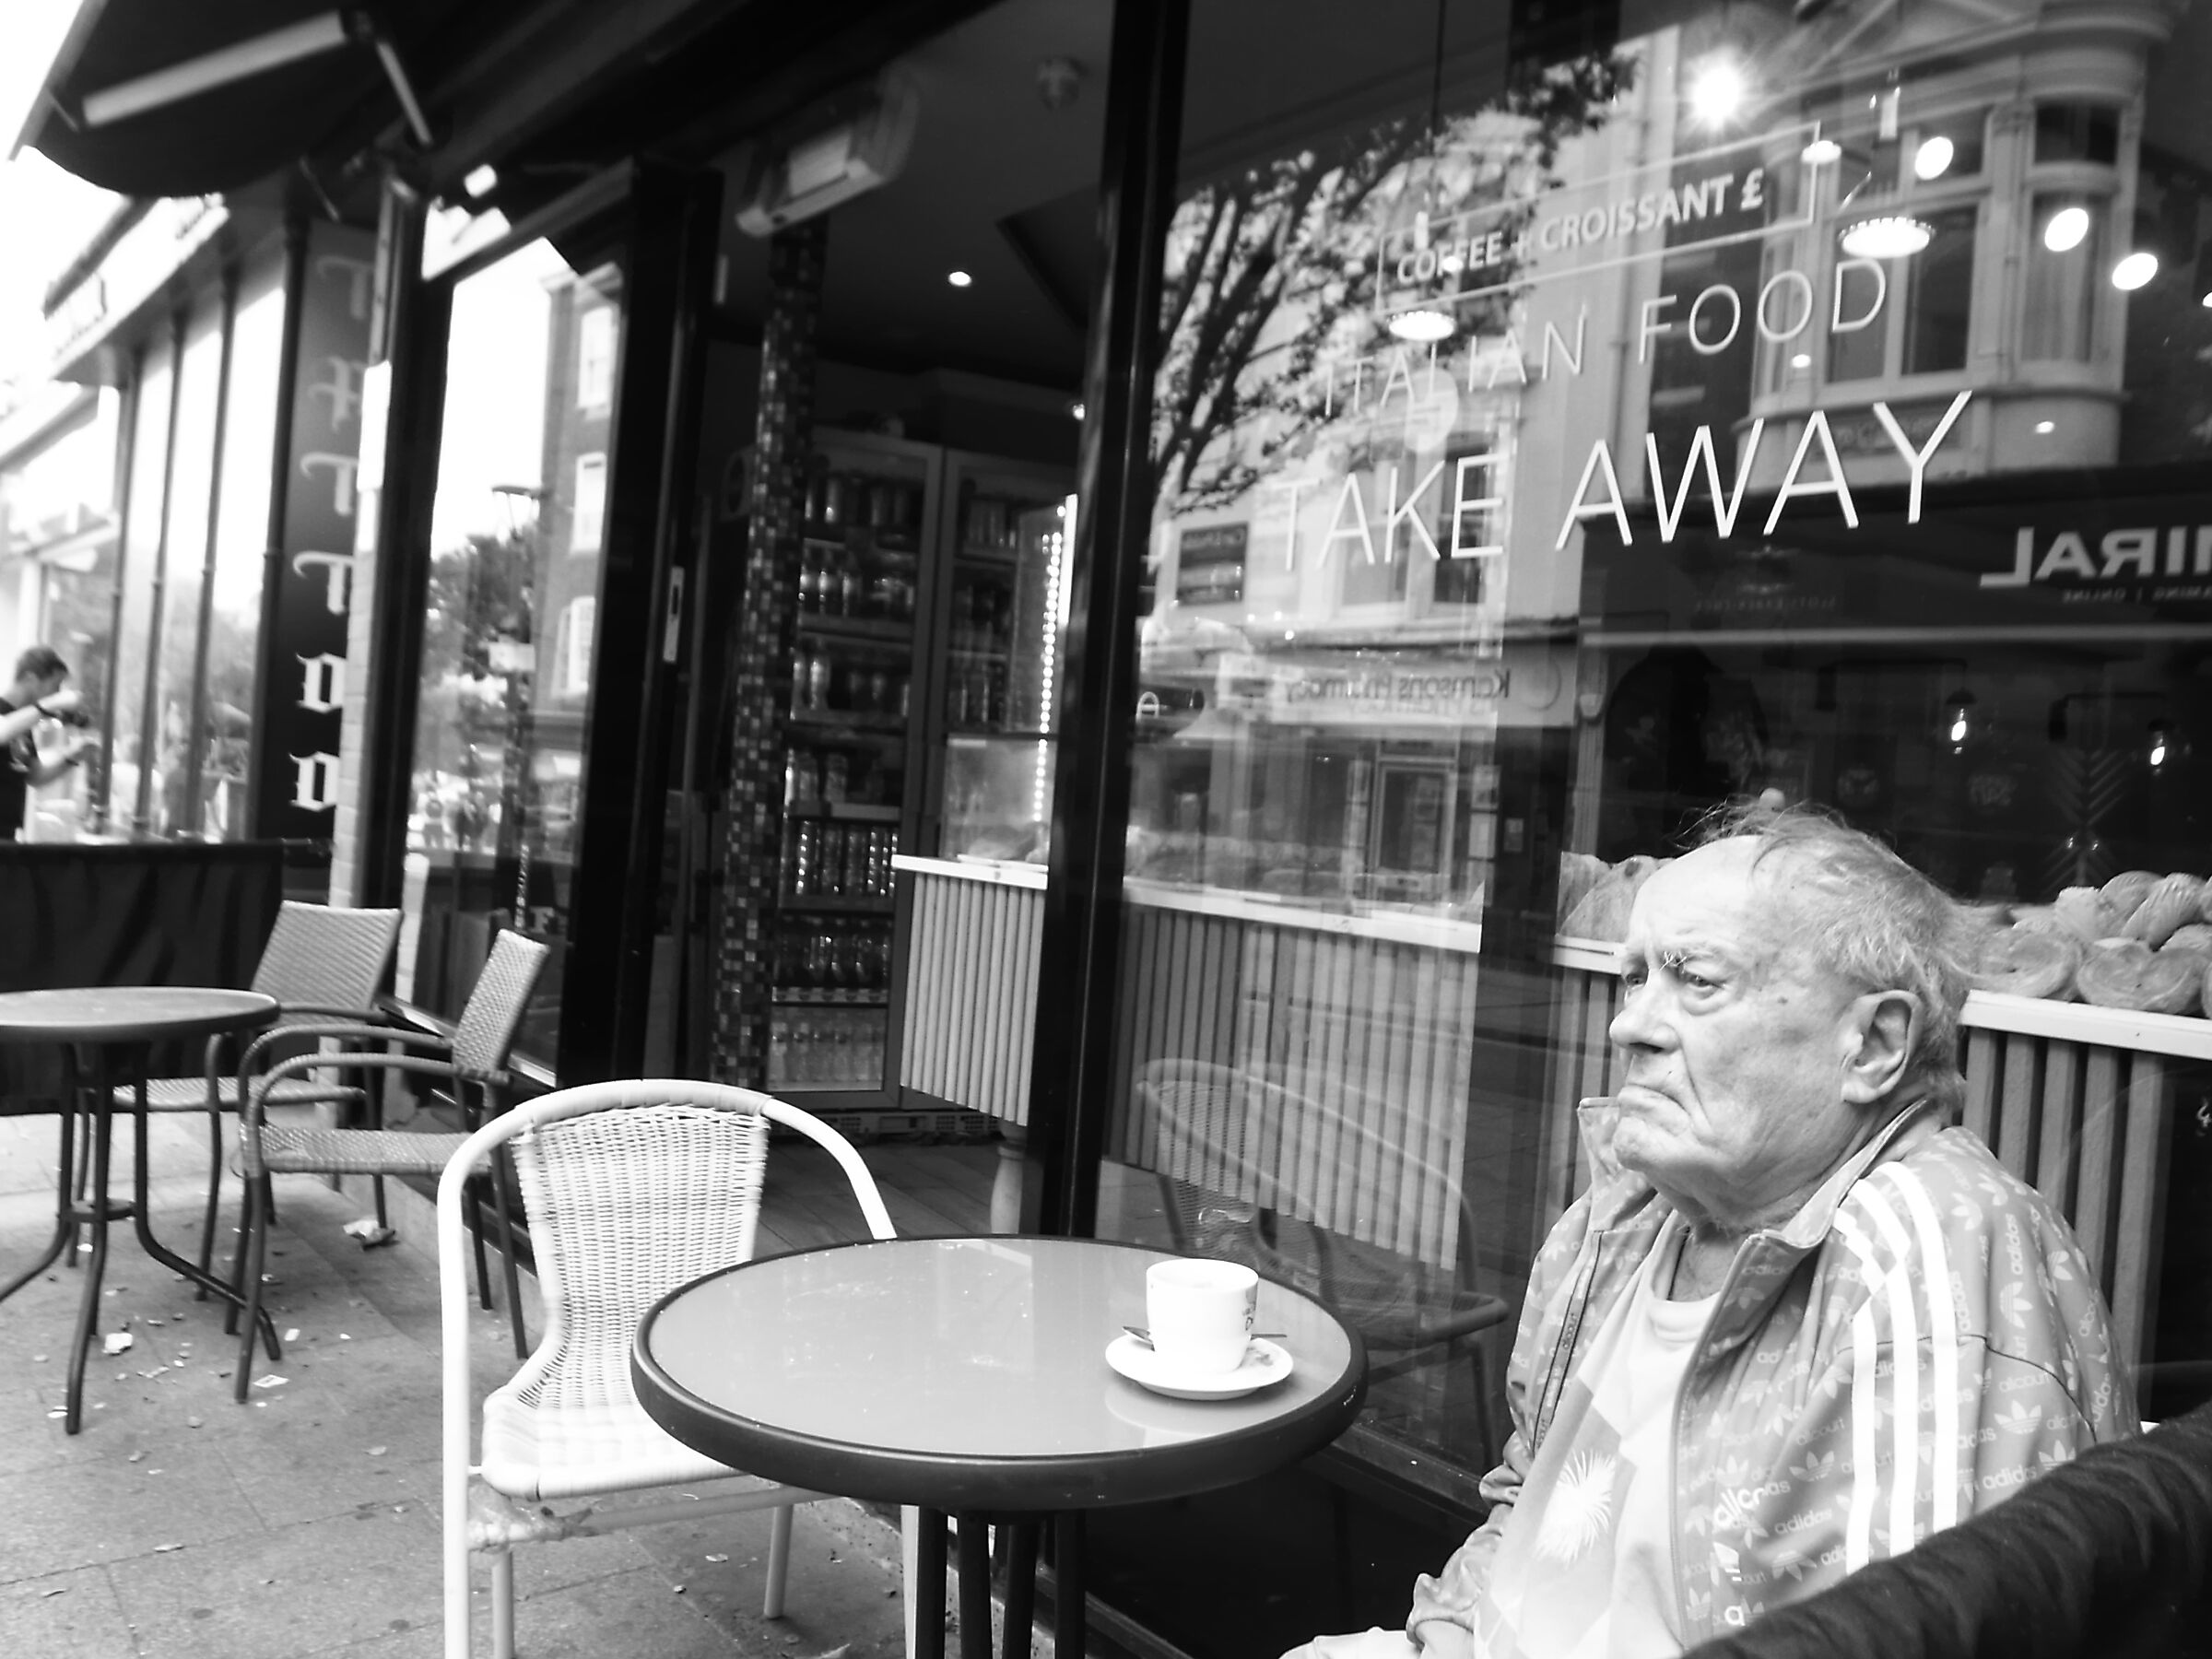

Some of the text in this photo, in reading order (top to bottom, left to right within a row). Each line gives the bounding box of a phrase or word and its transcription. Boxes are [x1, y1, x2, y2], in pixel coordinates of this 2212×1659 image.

[1397, 230, 1503, 284] COFFEE
[1540, 173, 1734, 252] CROISSANT
[1324, 257, 1886, 417] ITALIAN FOOD
[1271, 390, 1973, 571] TAKE AWAY
